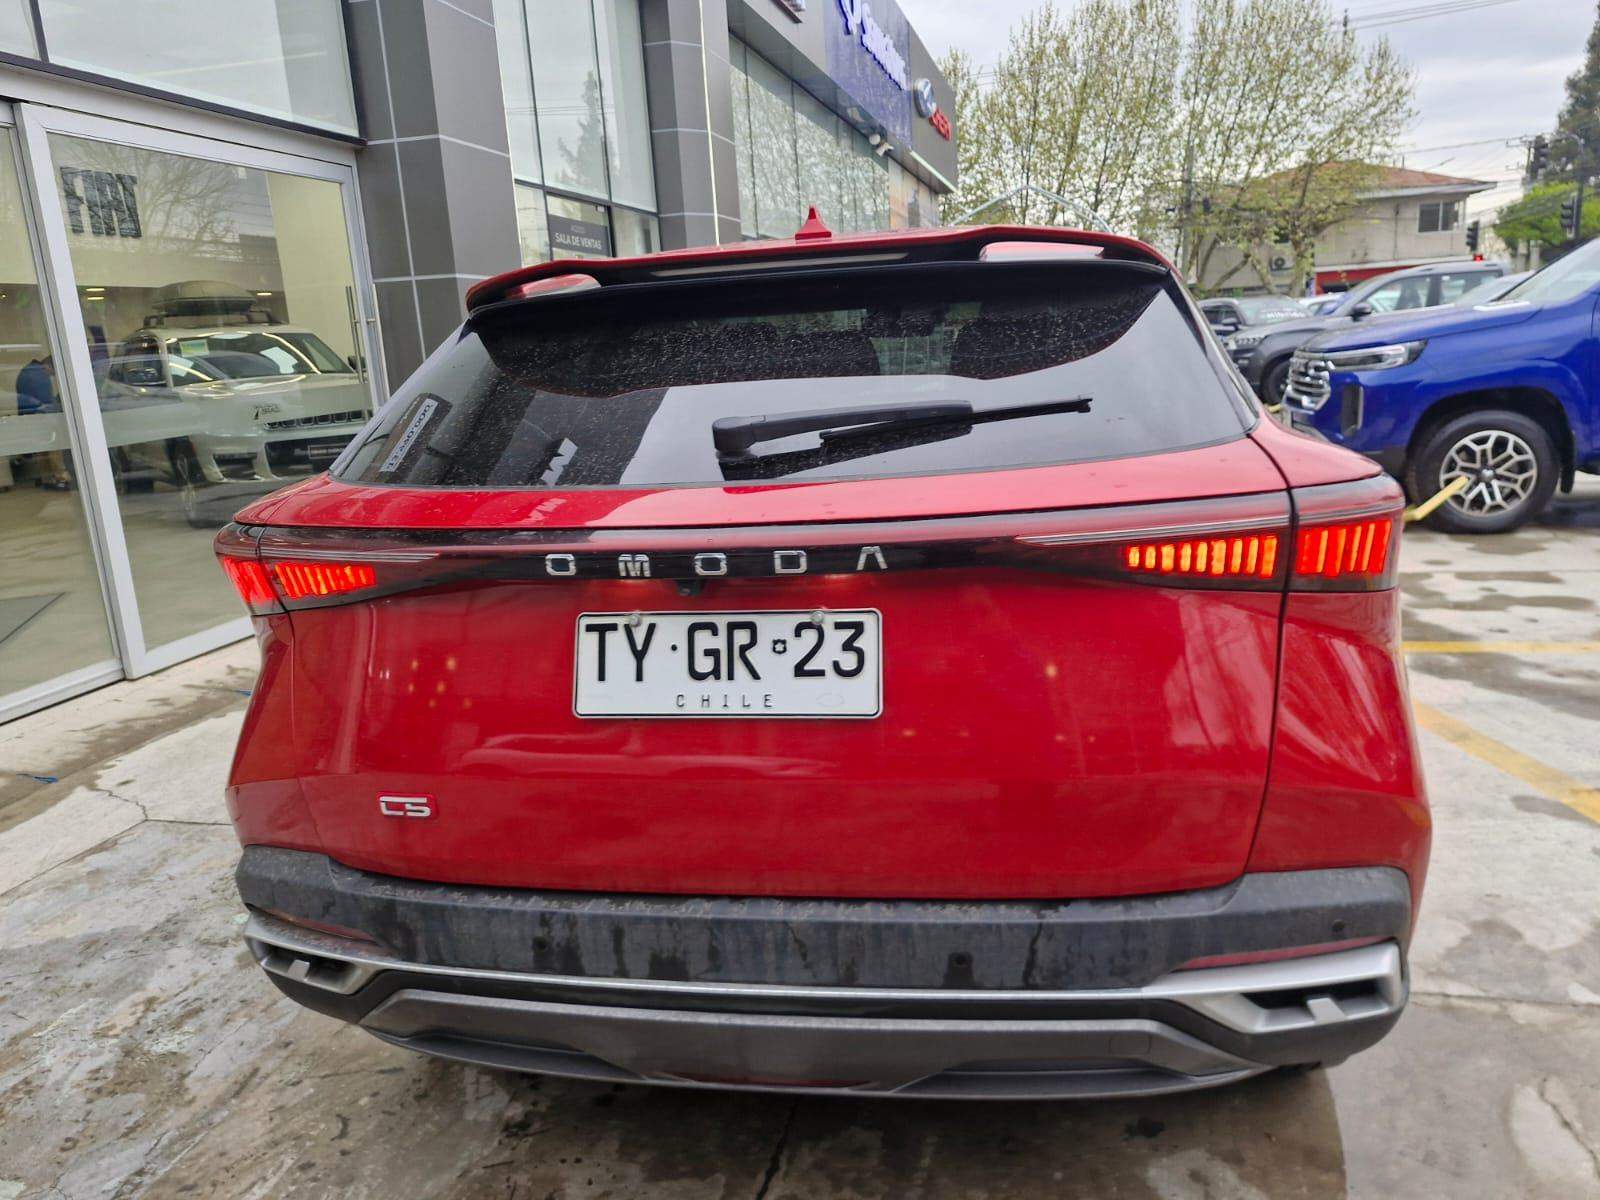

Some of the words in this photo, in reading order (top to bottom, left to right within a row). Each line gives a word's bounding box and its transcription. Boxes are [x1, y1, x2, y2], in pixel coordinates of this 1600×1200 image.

[60, 167, 142, 238] FIAT
[545, 545, 888, 577] OMODA
[676, 694, 773, 708] CHILE
